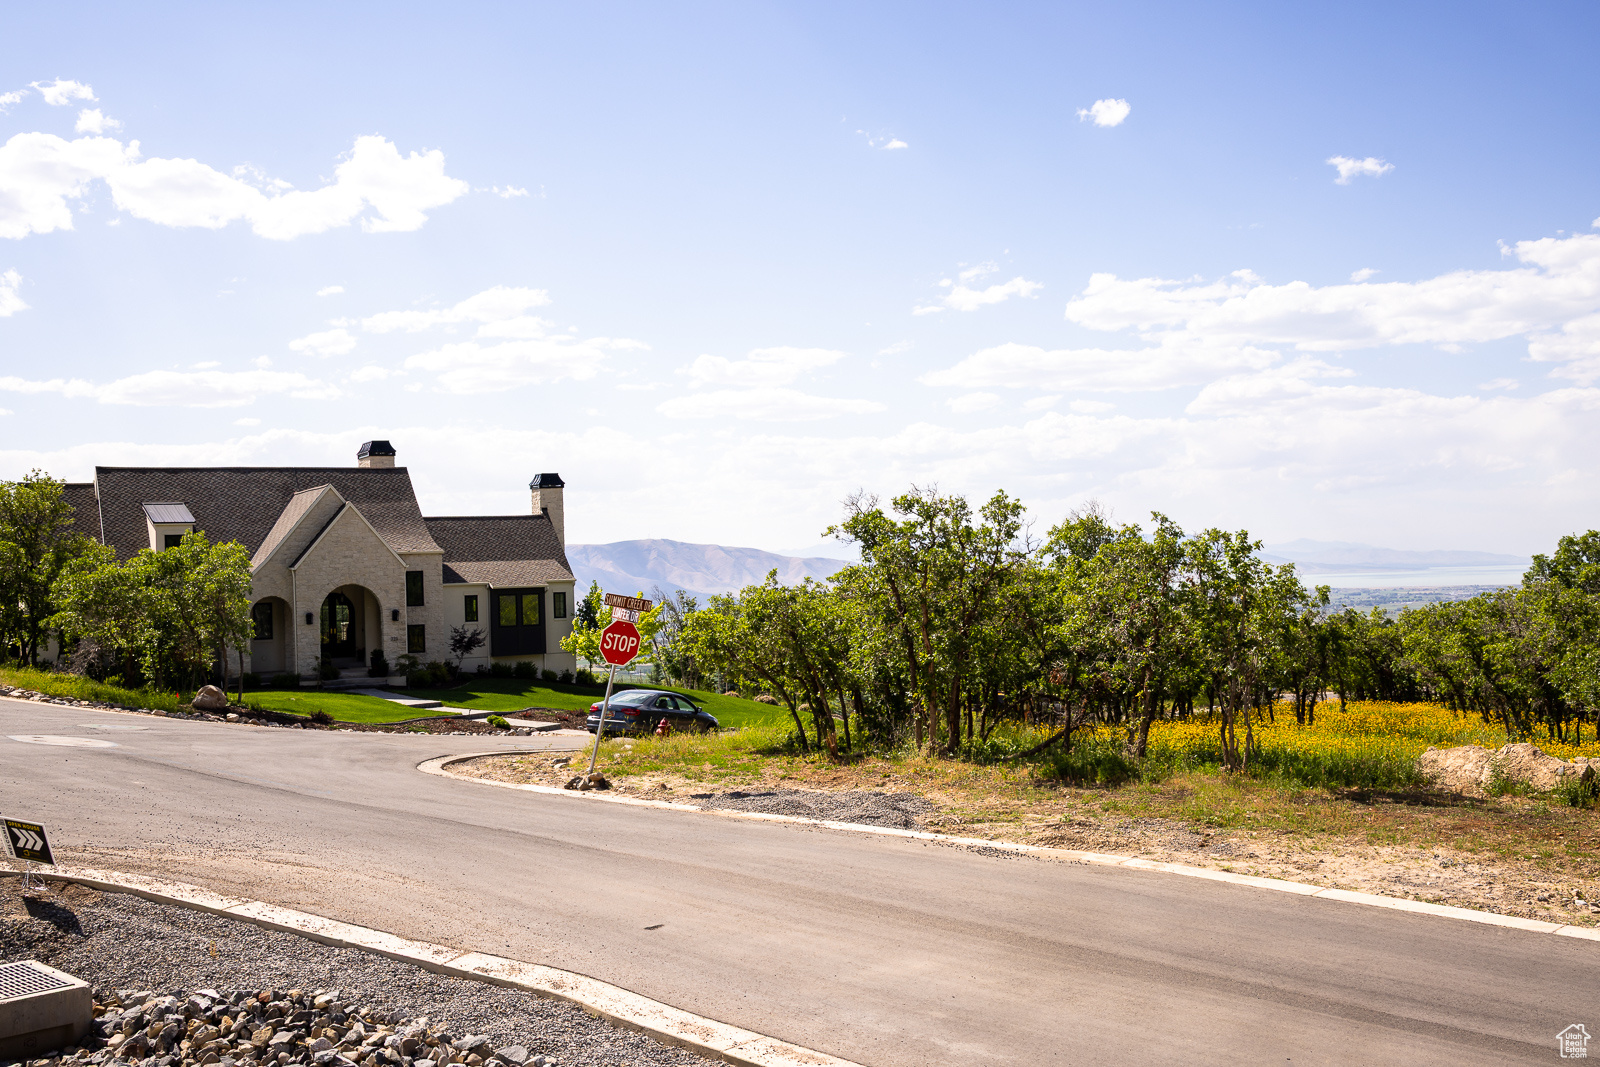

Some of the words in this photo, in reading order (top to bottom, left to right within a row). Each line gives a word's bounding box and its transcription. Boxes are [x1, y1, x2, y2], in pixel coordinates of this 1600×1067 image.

[605, 594, 626, 606] SUMMIT
[627, 598, 643, 610] CREEK
[644, 601, 652, 611] DR
[630, 611, 640, 622] DR
[604, 633, 637, 652] STOP
[1, 826, 13, 855] WELCOME
